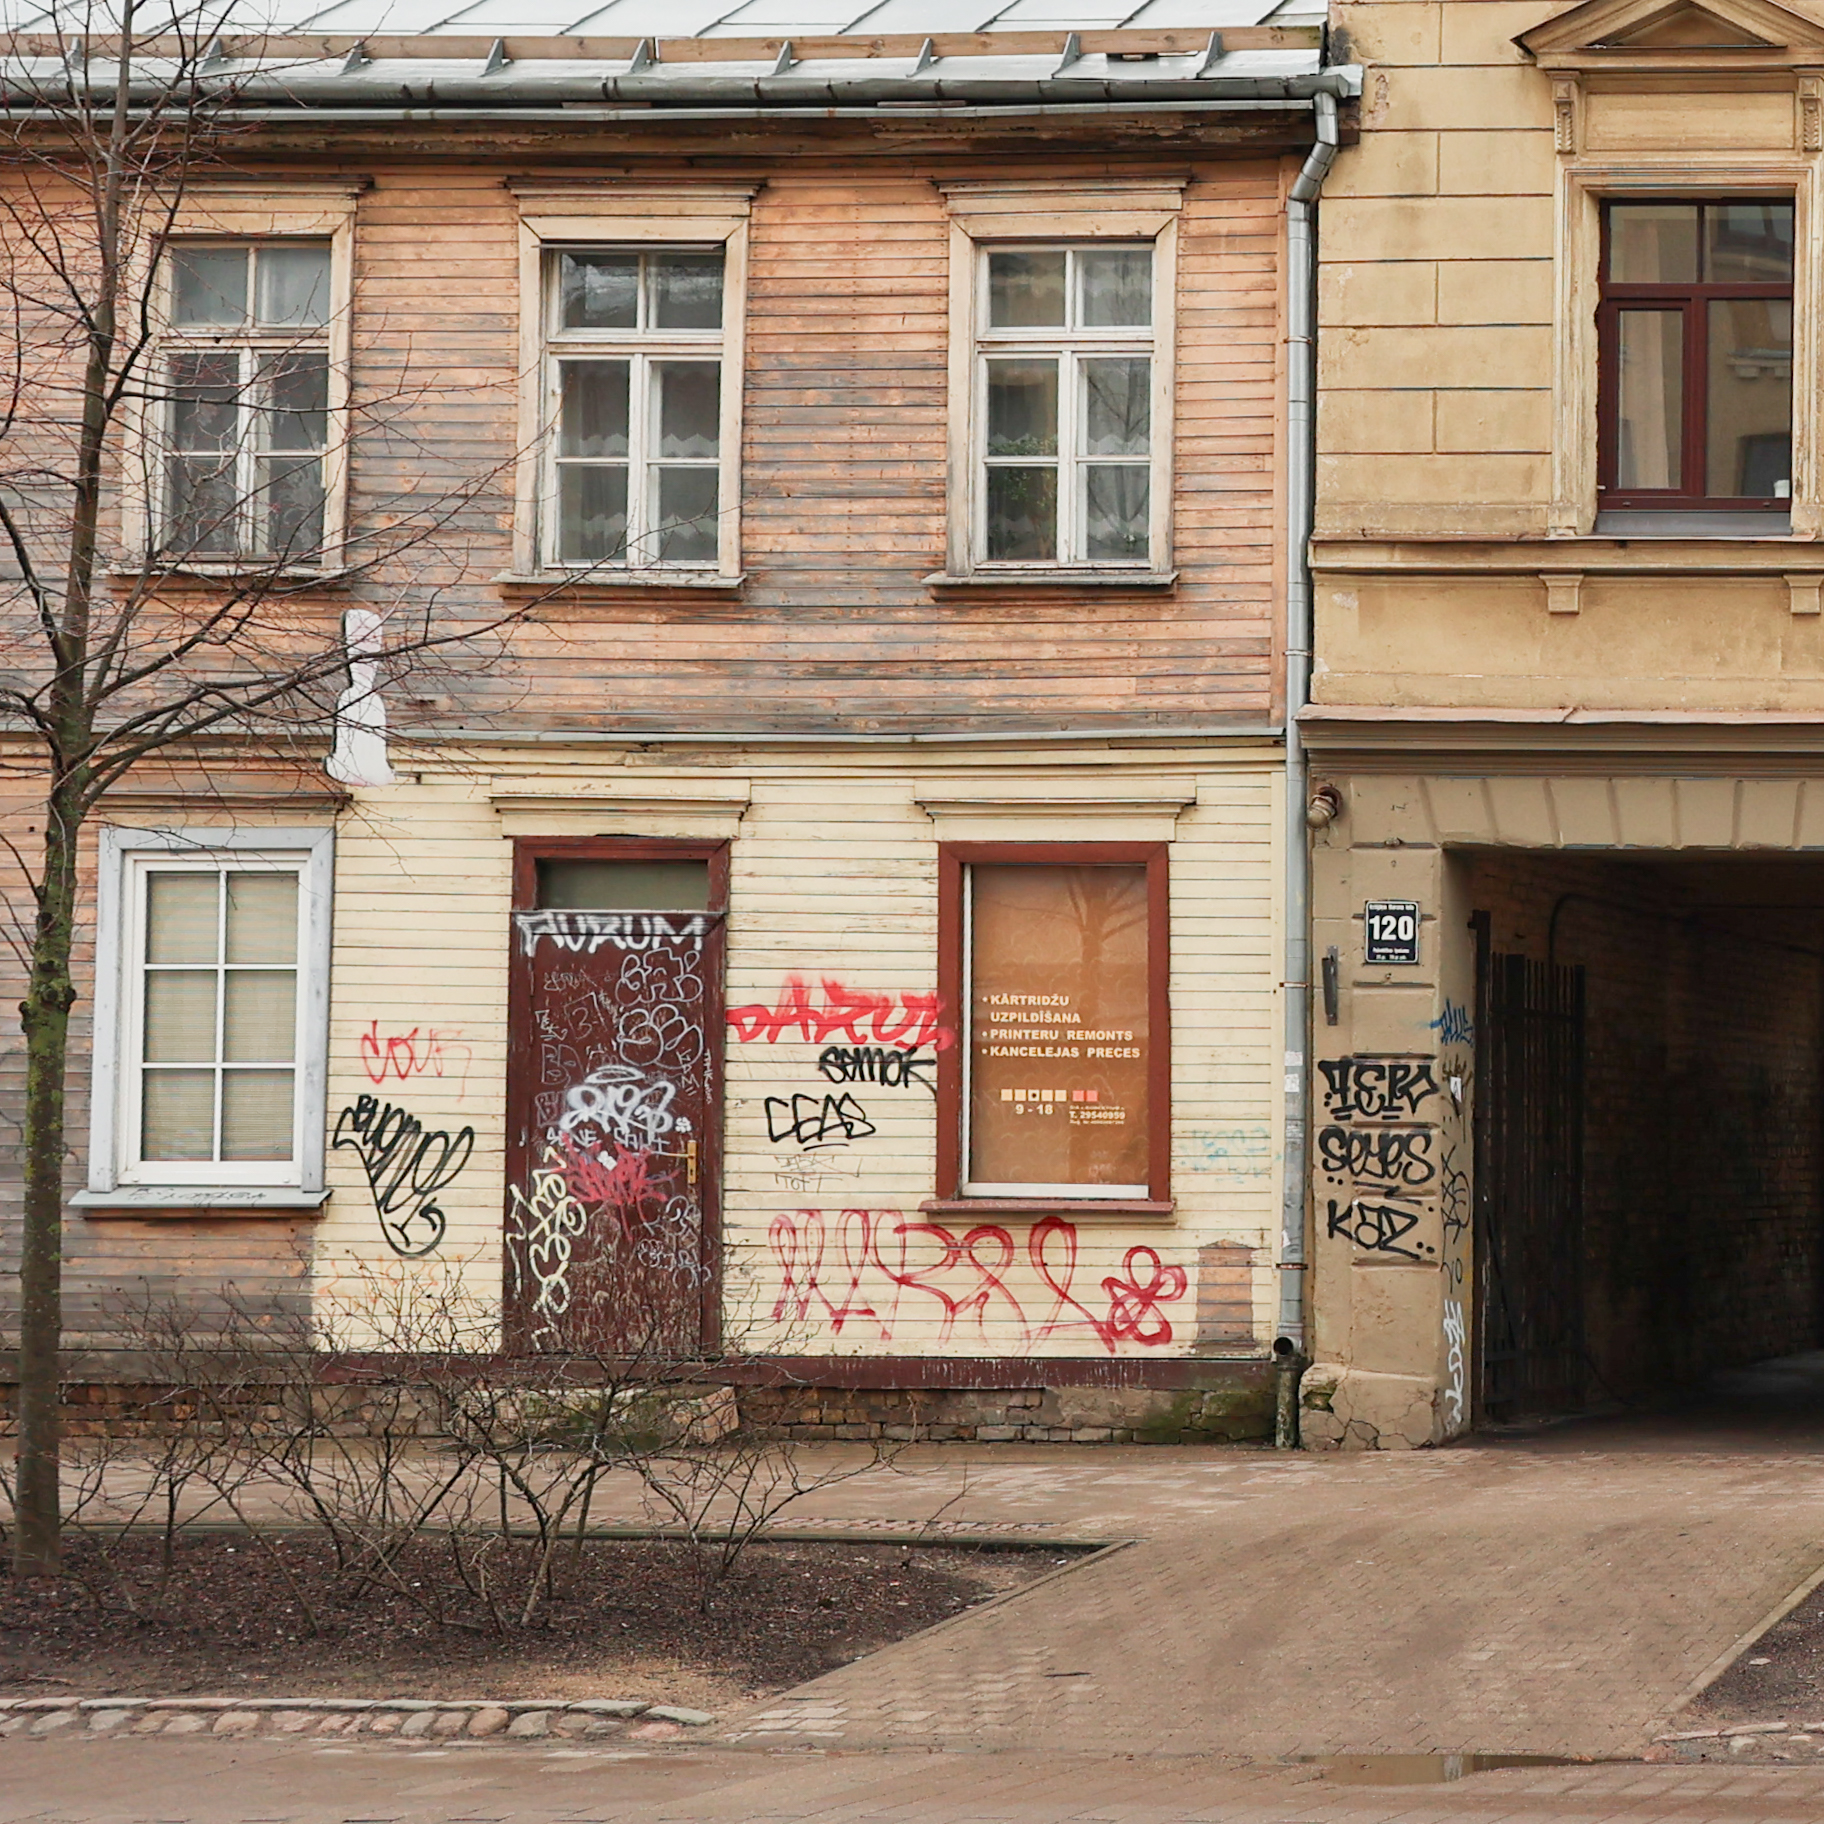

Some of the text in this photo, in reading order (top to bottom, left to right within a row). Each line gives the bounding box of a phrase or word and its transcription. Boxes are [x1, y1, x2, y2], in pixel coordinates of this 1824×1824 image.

[1369, 915, 1414, 941] 120
[990, 993, 1069, 1006] KĀRTRIDŽU
[990, 1010, 1081, 1023] UZPILDĪŠANA
[990, 1029, 1133, 1041] PRINTERU REMONTS
[990, 1046, 1140, 1058] KANCELEJAS PRECES
[1015, 1104, 1025, 1115] 9
[1037, 1104, 1053, 1115] 18
[1069, 1111, 1078, 1119] T.
